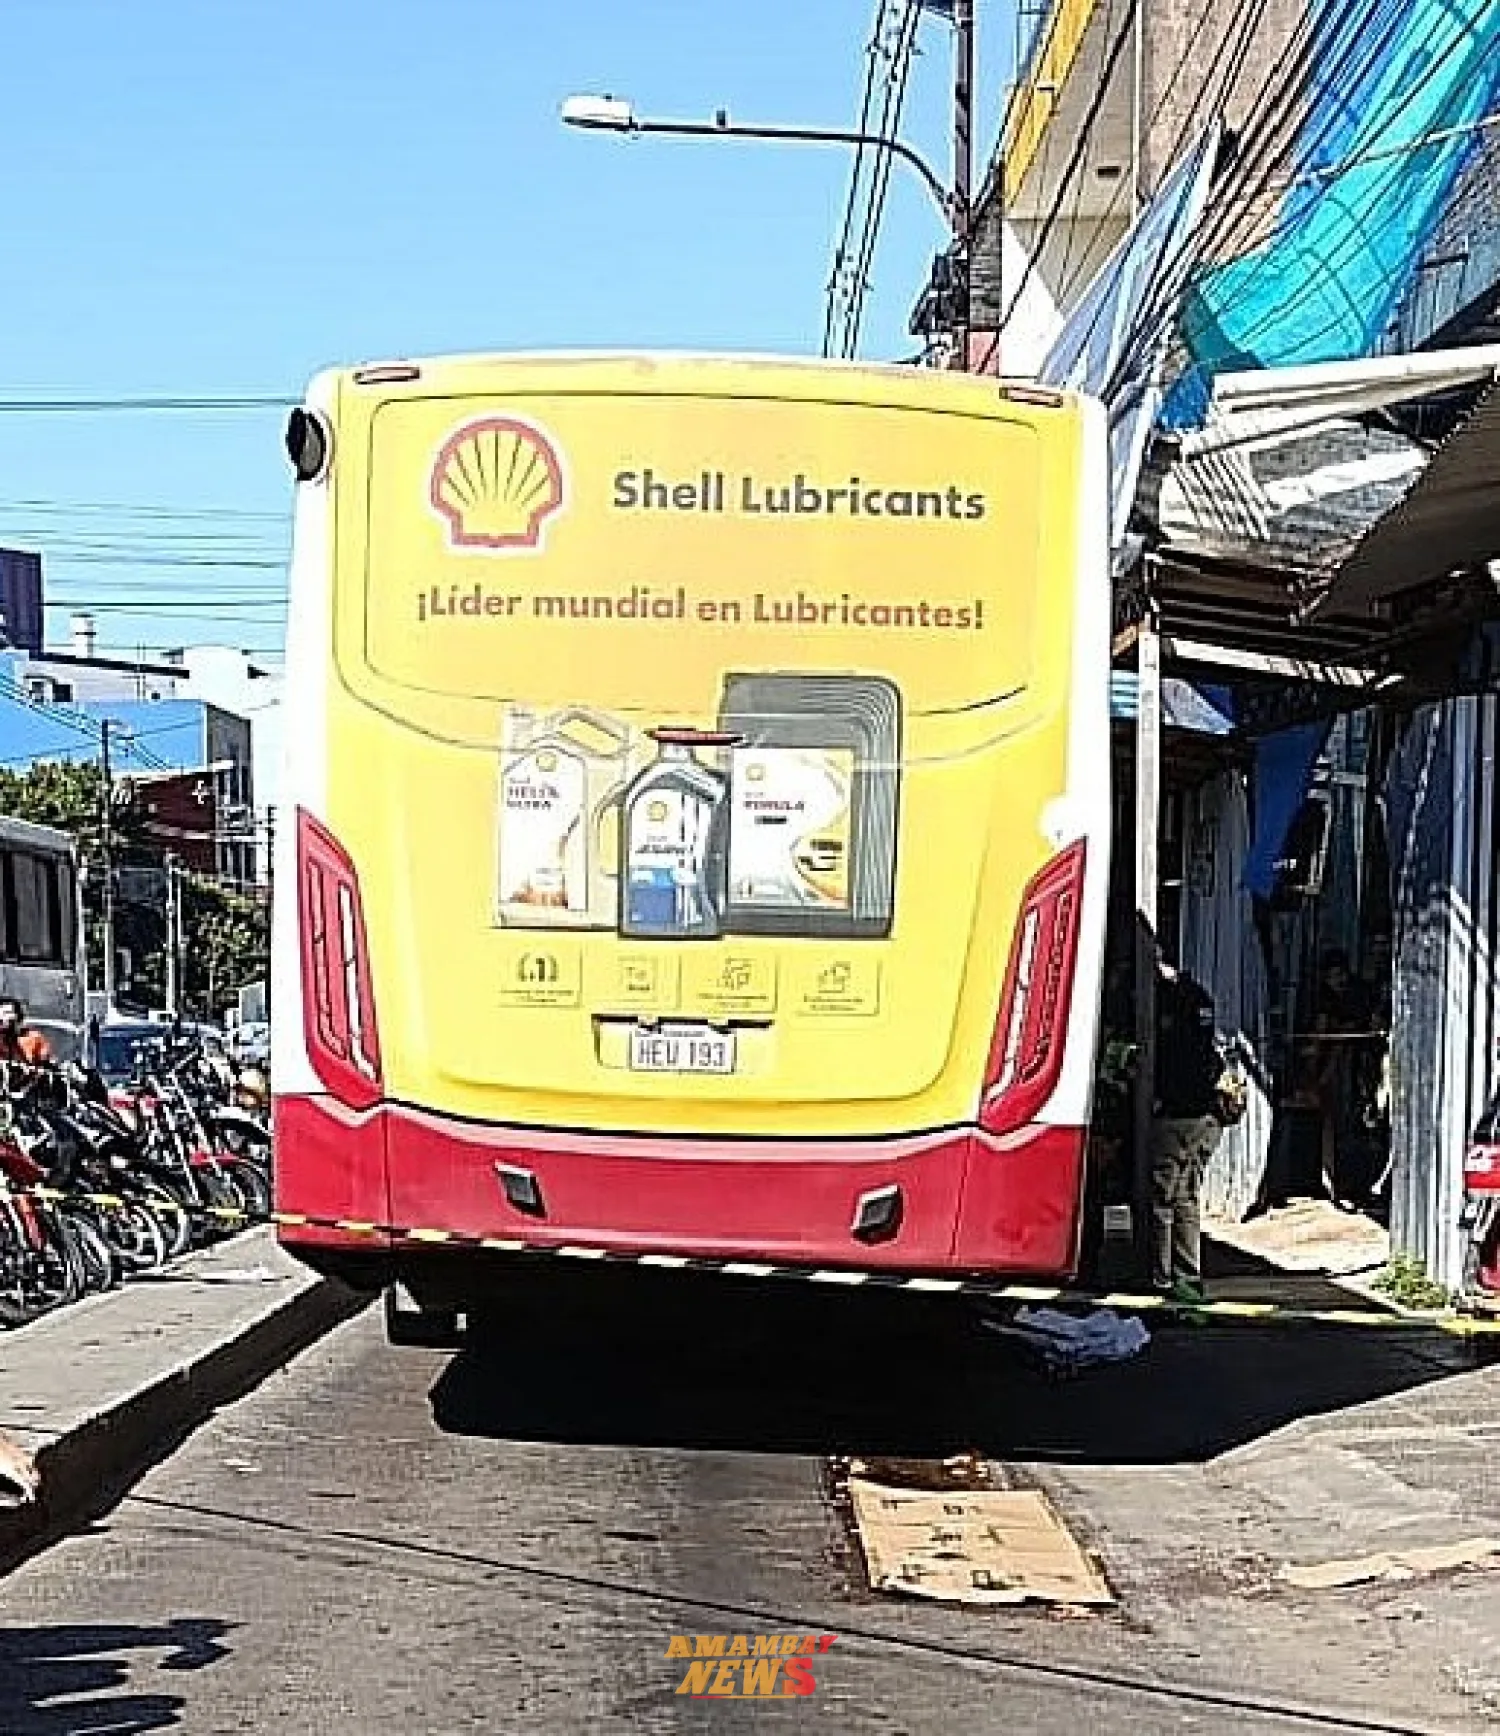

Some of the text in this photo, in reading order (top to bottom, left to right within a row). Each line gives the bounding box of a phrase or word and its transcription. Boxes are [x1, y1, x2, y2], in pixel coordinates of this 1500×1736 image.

[613, 468, 986, 520] Shell Lubricants
[532, 585, 686, 619] mundial
[697, 599, 741, 622] en
[753, 591, 984, 629] Lubricantes!
